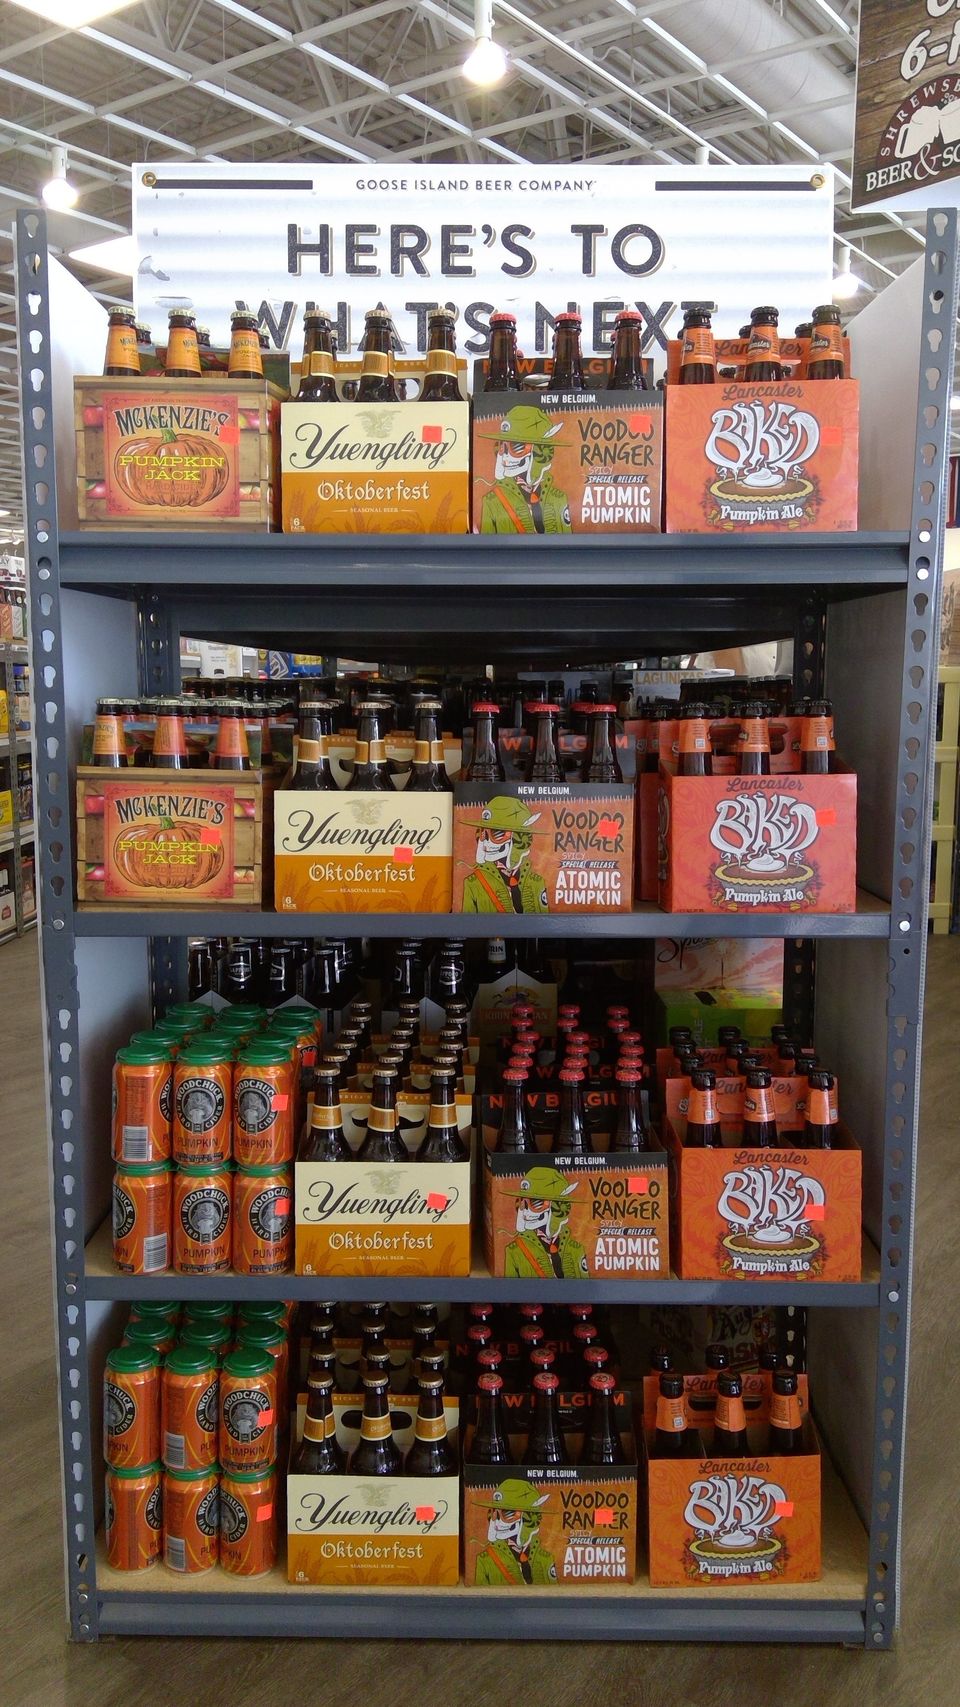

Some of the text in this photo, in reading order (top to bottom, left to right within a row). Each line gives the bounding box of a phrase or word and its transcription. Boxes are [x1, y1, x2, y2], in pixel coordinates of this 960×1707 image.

[356, 179, 594, 191] GOOSE ISLAND BEER COMPANY
[865, 163, 913, 192] BEER
[287, 223, 666, 278] HERE'S TO
[716, 338, 804, 357] Lanter
[540, 394, 597, 404] NEW BELGIUM
[722, 385, 804, 400] Lancaster
[704, 400, 820, 472] BAKED
[289, 422, 458, 470] Yuengling
[580, 442, 655, 467] RANGER
[119, 455, 225, 468] PUMPKIN
[144, 469, 200, 481] JACK
[317, 479, 431, 502] Oktoberfest
[582, 486, 651, 506] ATOMIC
[293, 516, 301, 526] 6
[581, 507, 651, 524] PUMPKIN
[719, 504, 804, 525] Pumpkin Ale
[517, 786, 570, 796] NEW BELGIUM
[726, 776, 804, 793] Lancaster
[282, 809, 442, 855] Yuengling
[709, 792, 819, 862] BAKED
[119, 841, 219, 852] PUMPKIN
[554, 831, 625, 853] RANGER
[143, 853, 197, 865] JACK
[309, 862, 416, 883] Oktoberfest
[555, 870, 621, 889] ATOMIC
[285, 896, 293, 904] 6
[555, 890, 621, 905] PUMPKIN
[724, 887, 804, 907] Pumpkin Ale
[554, 1156, 608, 1167] NEW BELGIUM
[732, 1150, 810, 1166] Lancaster
[588, 1177, 660, 1198] VOOO
[717, 1166, 826, 1228] BAKED
[181, 1190, 229, 1214] WOODCHUCK
[592, 1199, 661, 1221] RANGER
[328, 1230, 434, 1251] Oktoberfest
[595, 1237, 659, 1255] ATOMIC
[183, 1246, 225, 1258] PUMPKIN
[305, 1263, 312, 1271] 6
[594, 1256, 660, 1271] PUMPKIN
[732, 1256, 810, 1276] Pumpkin Ale
[686, 1377, 767, 1393] Lanter
[224, 1391, 270, 1412] WOODCHUCK
[115, 1413, 134, 1434] CIDER
[224, 1445, 265, 1457] PUMPKIN
[527, 1469, 578, 1479] NEW BELGIUM
[698, 1461, 772, 1475] Lancaster
[684, 1474, 788, 1533] BAKED
[562, 1510, 630, 1530] RANER
[320, 1541, 424, 1560] Oktoberfest
[564, 1547, 626, 1564] ATOMIC
[563, 1564, 627, 1577] PUMPKIN
[698, 1560, 773, 1579] Pumpkin Ale
